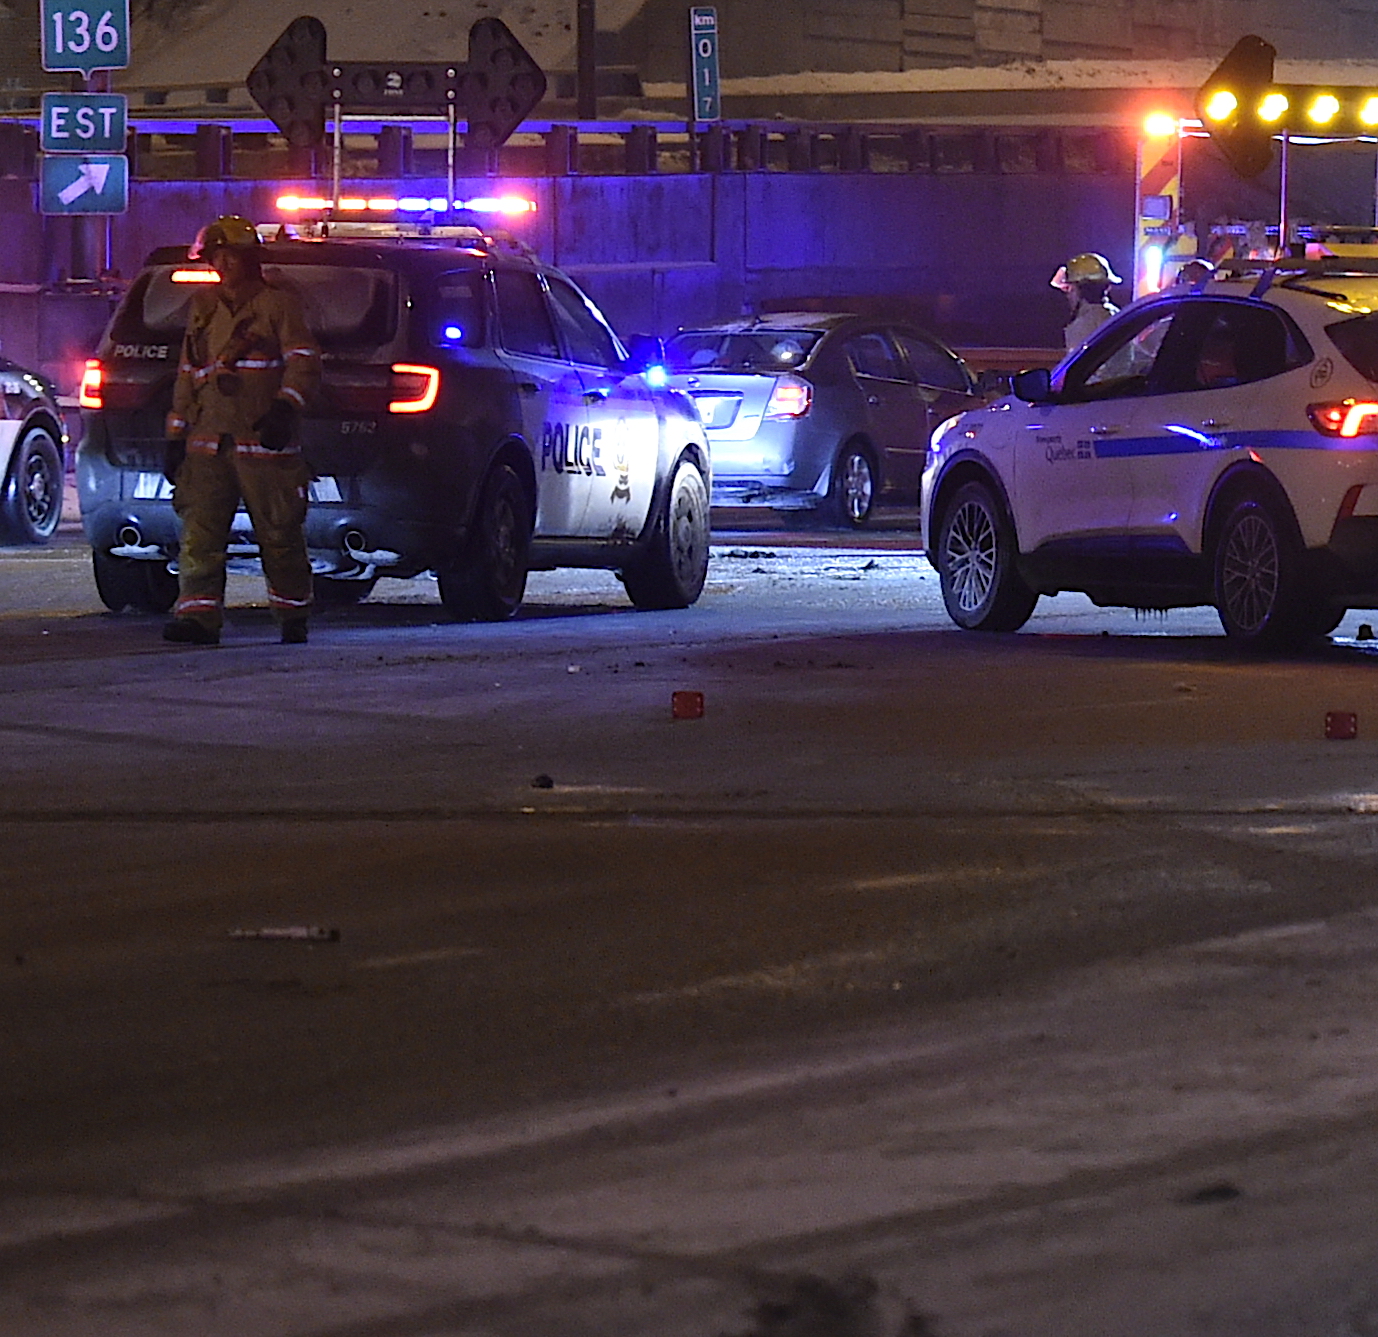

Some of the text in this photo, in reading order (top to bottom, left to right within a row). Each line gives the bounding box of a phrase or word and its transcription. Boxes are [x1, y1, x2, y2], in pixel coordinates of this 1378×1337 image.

[52, 10, 119, 54] 136
[694, 15, 715, 26] km
[51, 106, 117, 139] EST
[114, 344, 169, 359] POLICE
[542, 421, 606, 477] POLICE
